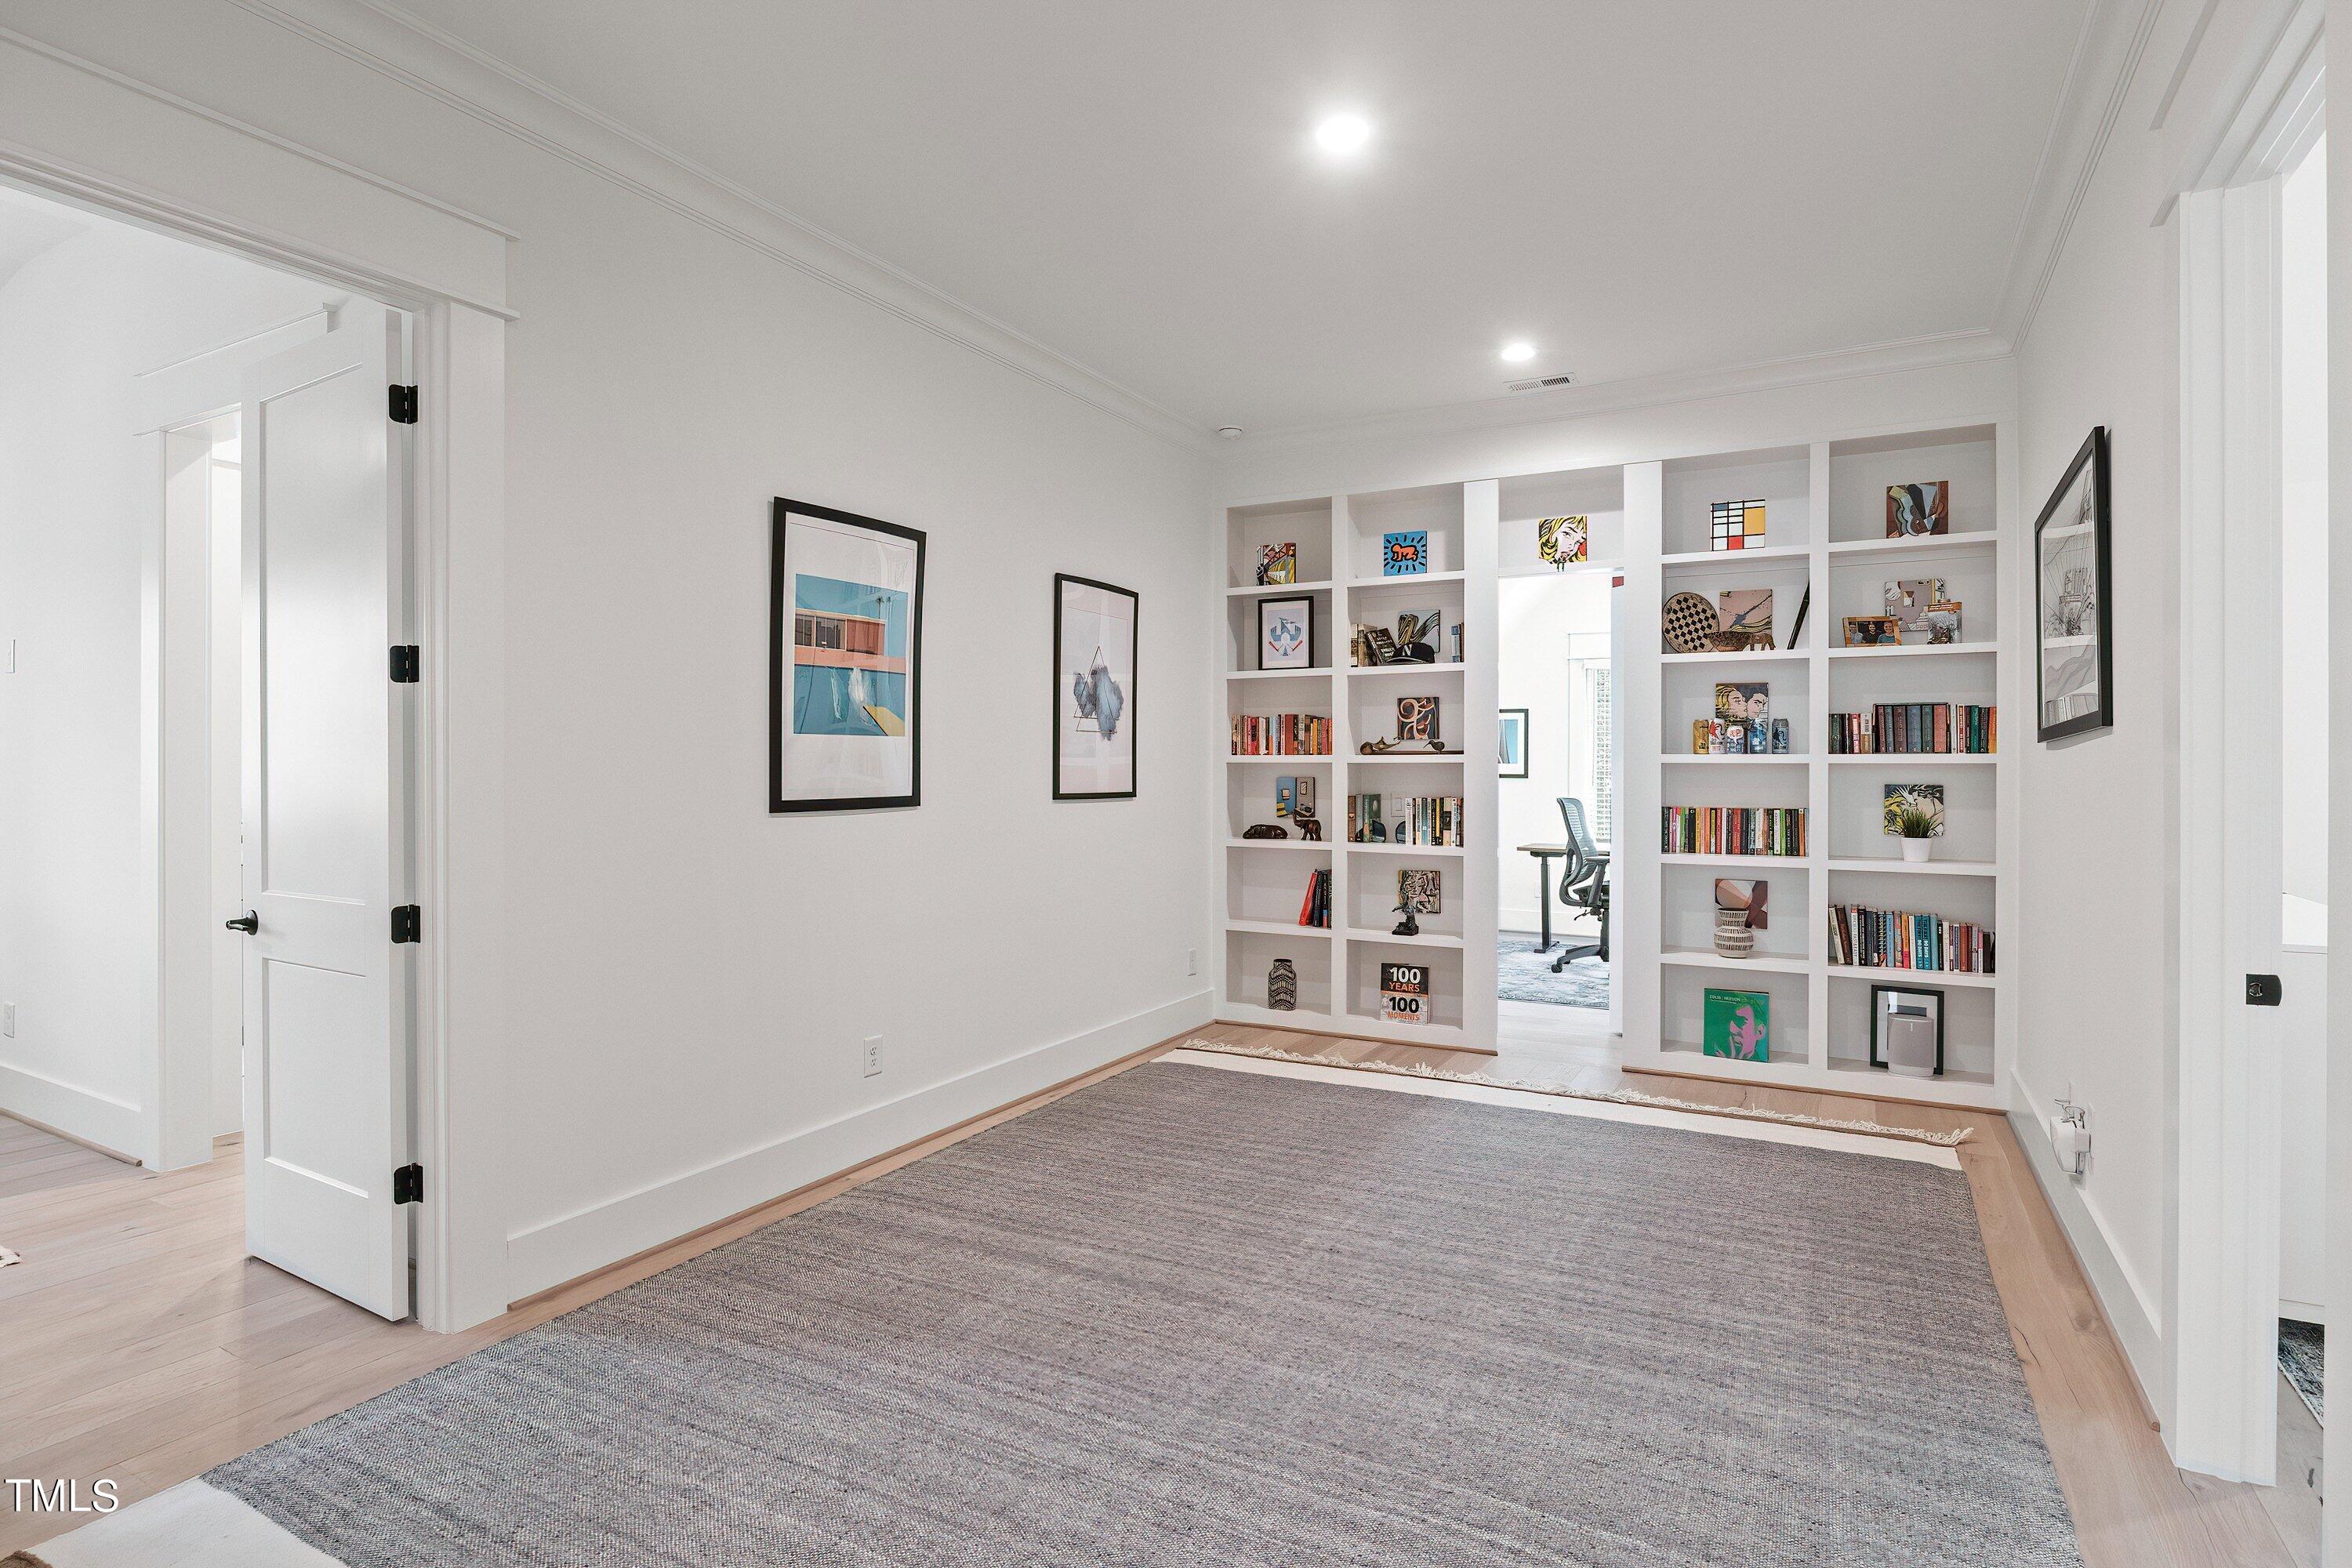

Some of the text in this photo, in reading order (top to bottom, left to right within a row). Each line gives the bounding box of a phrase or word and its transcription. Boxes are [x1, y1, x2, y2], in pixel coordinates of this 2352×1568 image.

[1390, 967, 1421, 984] 100
[1389, 982, 1420, 992] YEARS
[1388, 996, 1420, 1014] 100
